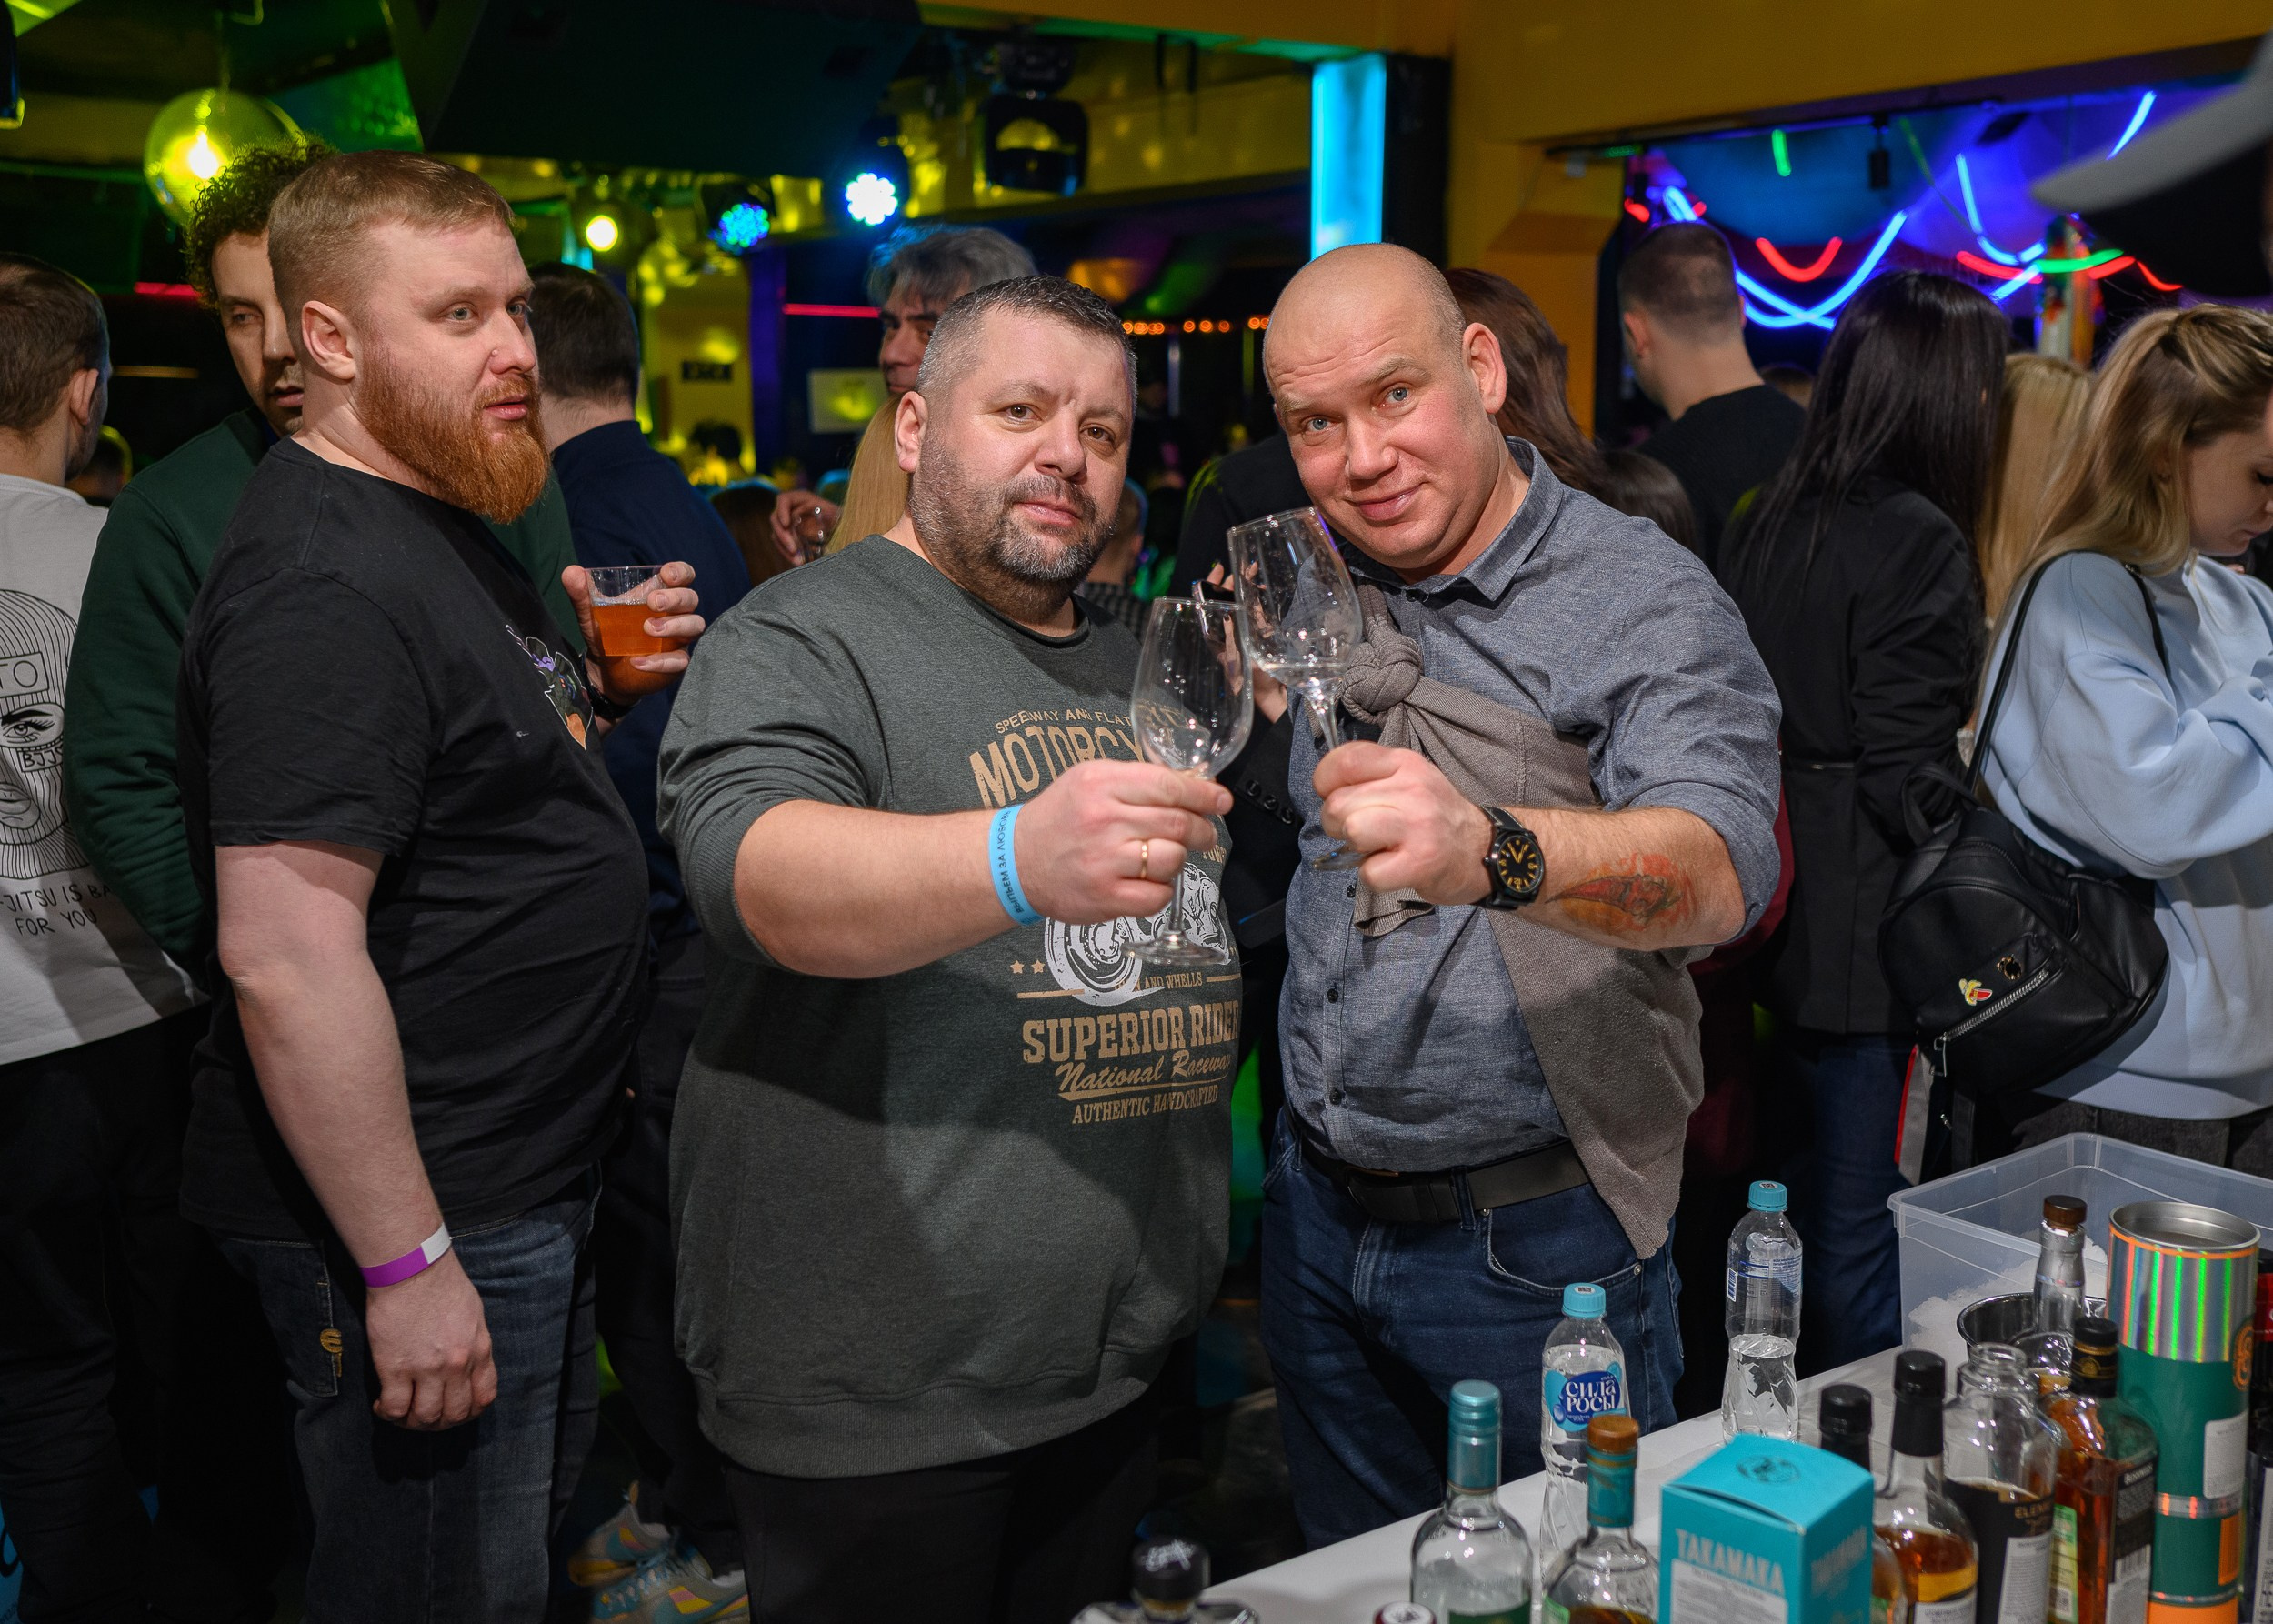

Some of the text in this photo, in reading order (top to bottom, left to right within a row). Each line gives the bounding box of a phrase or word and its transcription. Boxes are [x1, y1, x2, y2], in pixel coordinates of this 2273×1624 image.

[1094, 711, 1132, 727] FLAT
[996, 810, 1025, 914] ВЫПЬЕМ ЗА ЛЮБОВЬ
[62, 884, 83, 904] IS
[87, 884, 111, 898] BA
[15, 909, 97, 936] FOR YOU
[1165, 971, 1202, 989] WHELLS
[1023, 1007, 1187, 1064] SUPERIOR
[1055, 1055, 1165, 1092] National
[1072, 1084, 1219, 1124] AUTHENTIC HANDCRAFTED
